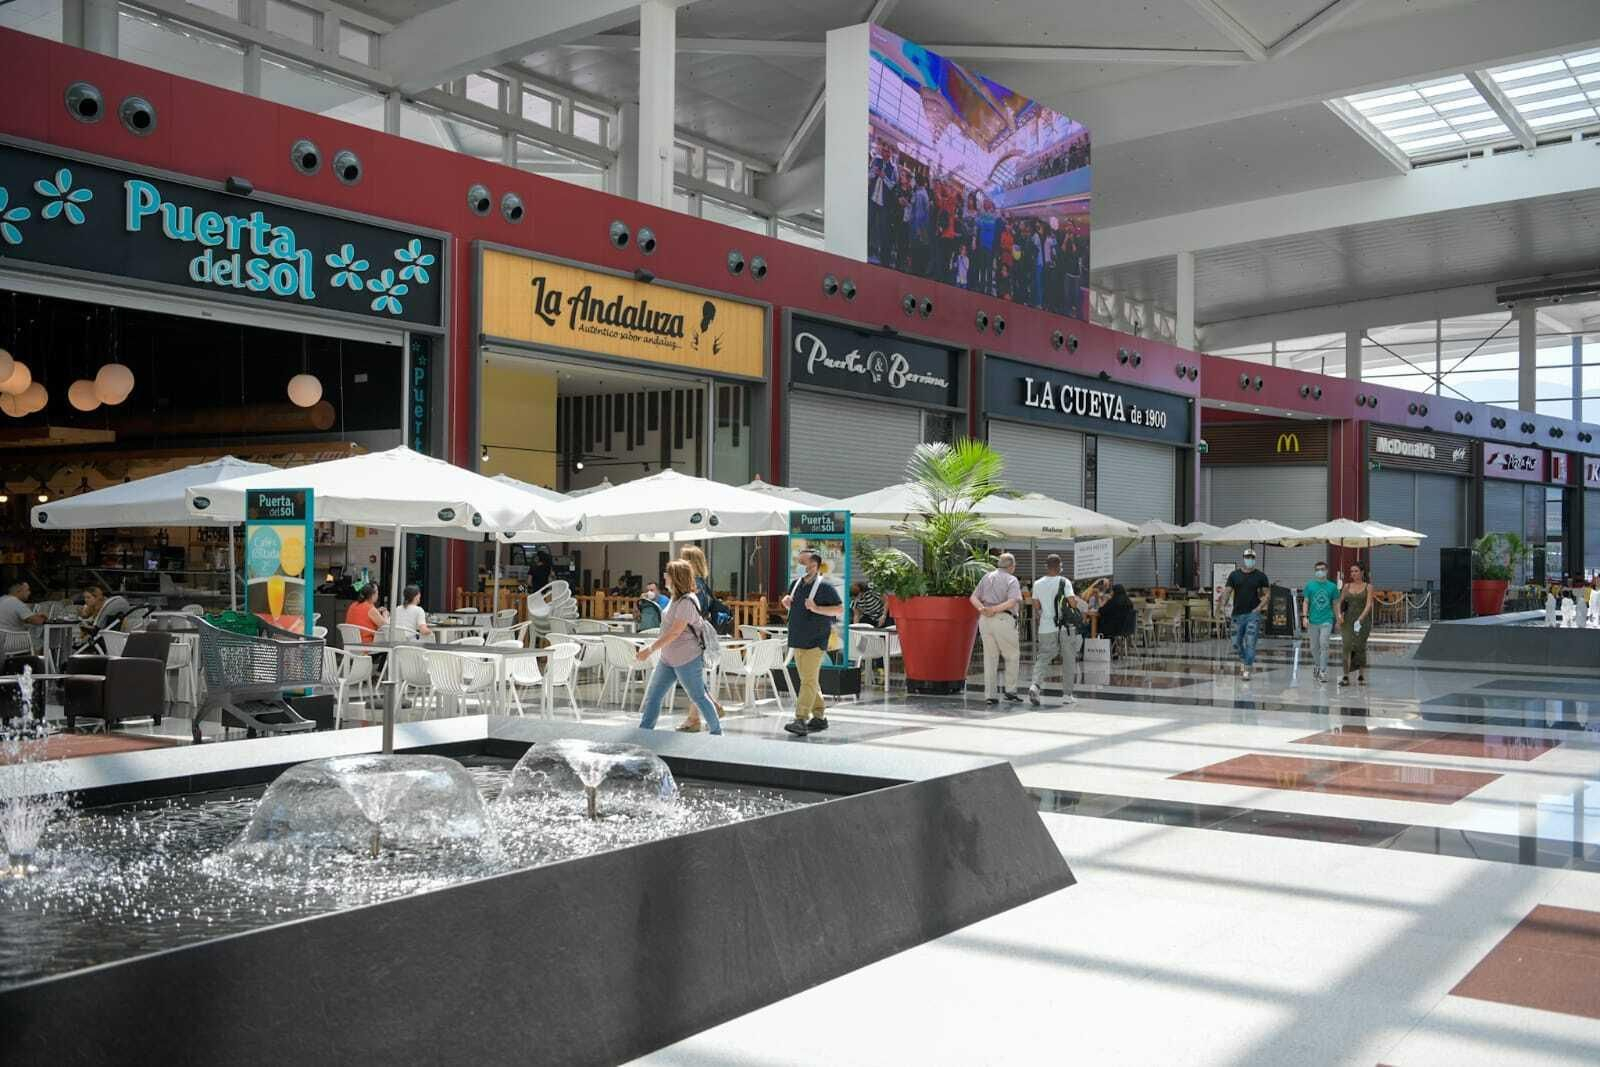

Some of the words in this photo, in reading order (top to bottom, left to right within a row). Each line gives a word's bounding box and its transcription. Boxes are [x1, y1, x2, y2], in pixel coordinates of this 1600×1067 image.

[123, 179, 300, 261] Puerta
[531, 276, 563, 327] La
[567, 285, 685, 339] Andaluza
[794, 332, 866, 375] Puerta
[1024, 376, 1056, 410] LA
[1060, 384, 1126, 422] CUEVA
[1130, 404, 1143, 425] de
[1145, 409, 1167, 429] 1900
[1375, 436, 1436, 460] McDonald's
[259, 494, 291, 508] Puerta
[801, 514, 832, 526] Puerta
